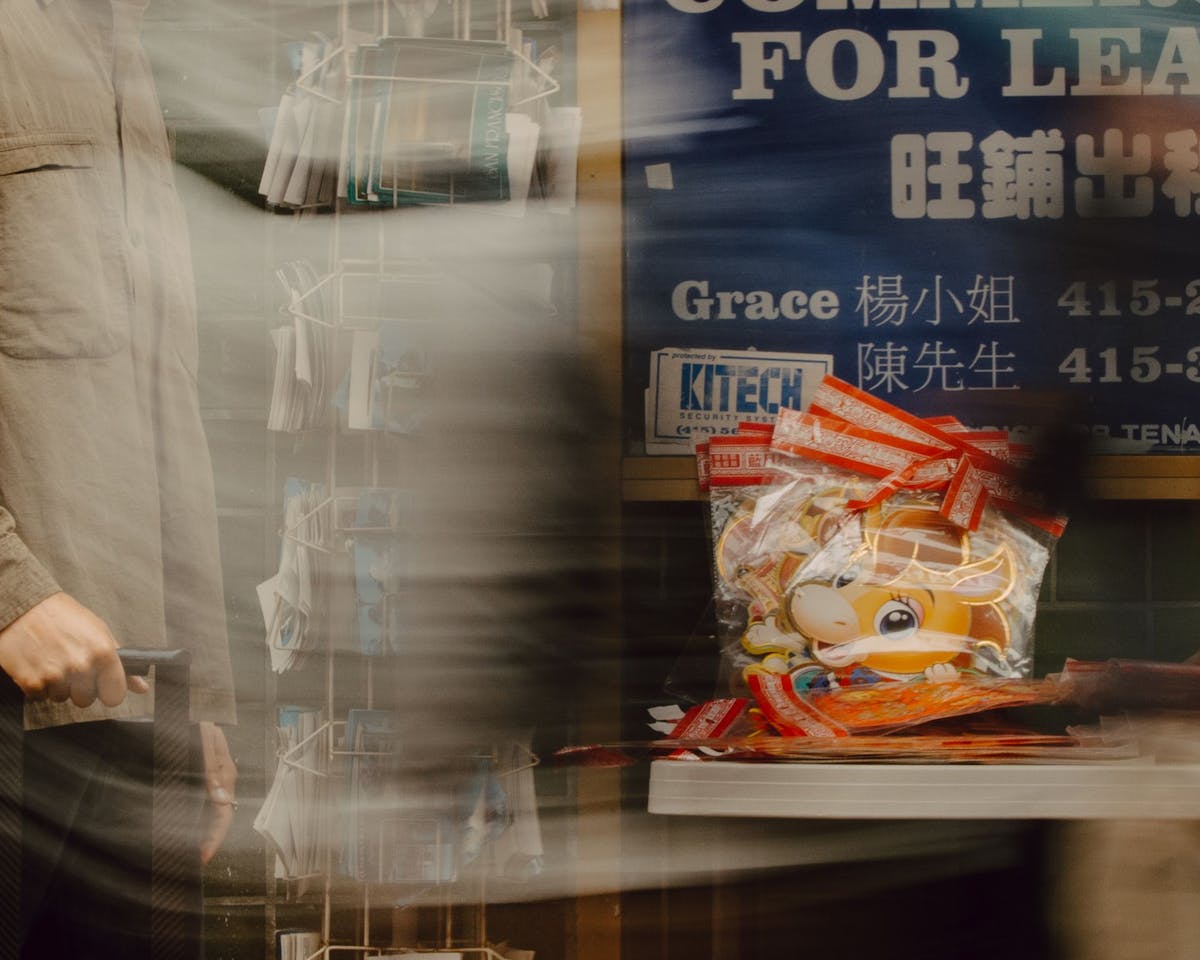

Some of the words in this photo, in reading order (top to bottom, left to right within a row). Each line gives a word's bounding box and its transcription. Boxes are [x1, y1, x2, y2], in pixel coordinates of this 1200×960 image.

[731, 28, 970, 100] FOR
[1001, 26, 1200, 97] LEA
[671, 280, 841, 321] Grace
[855, 274, 1021, 327] 楊小姐
[672, 352, 706, 360] protected
[707, 353, 717, 361] by
[857, 341, 1021, 393] 陳先生
[680, 363, 803, 413] KITECH
[680, 412, 739, 421] SECURITY
